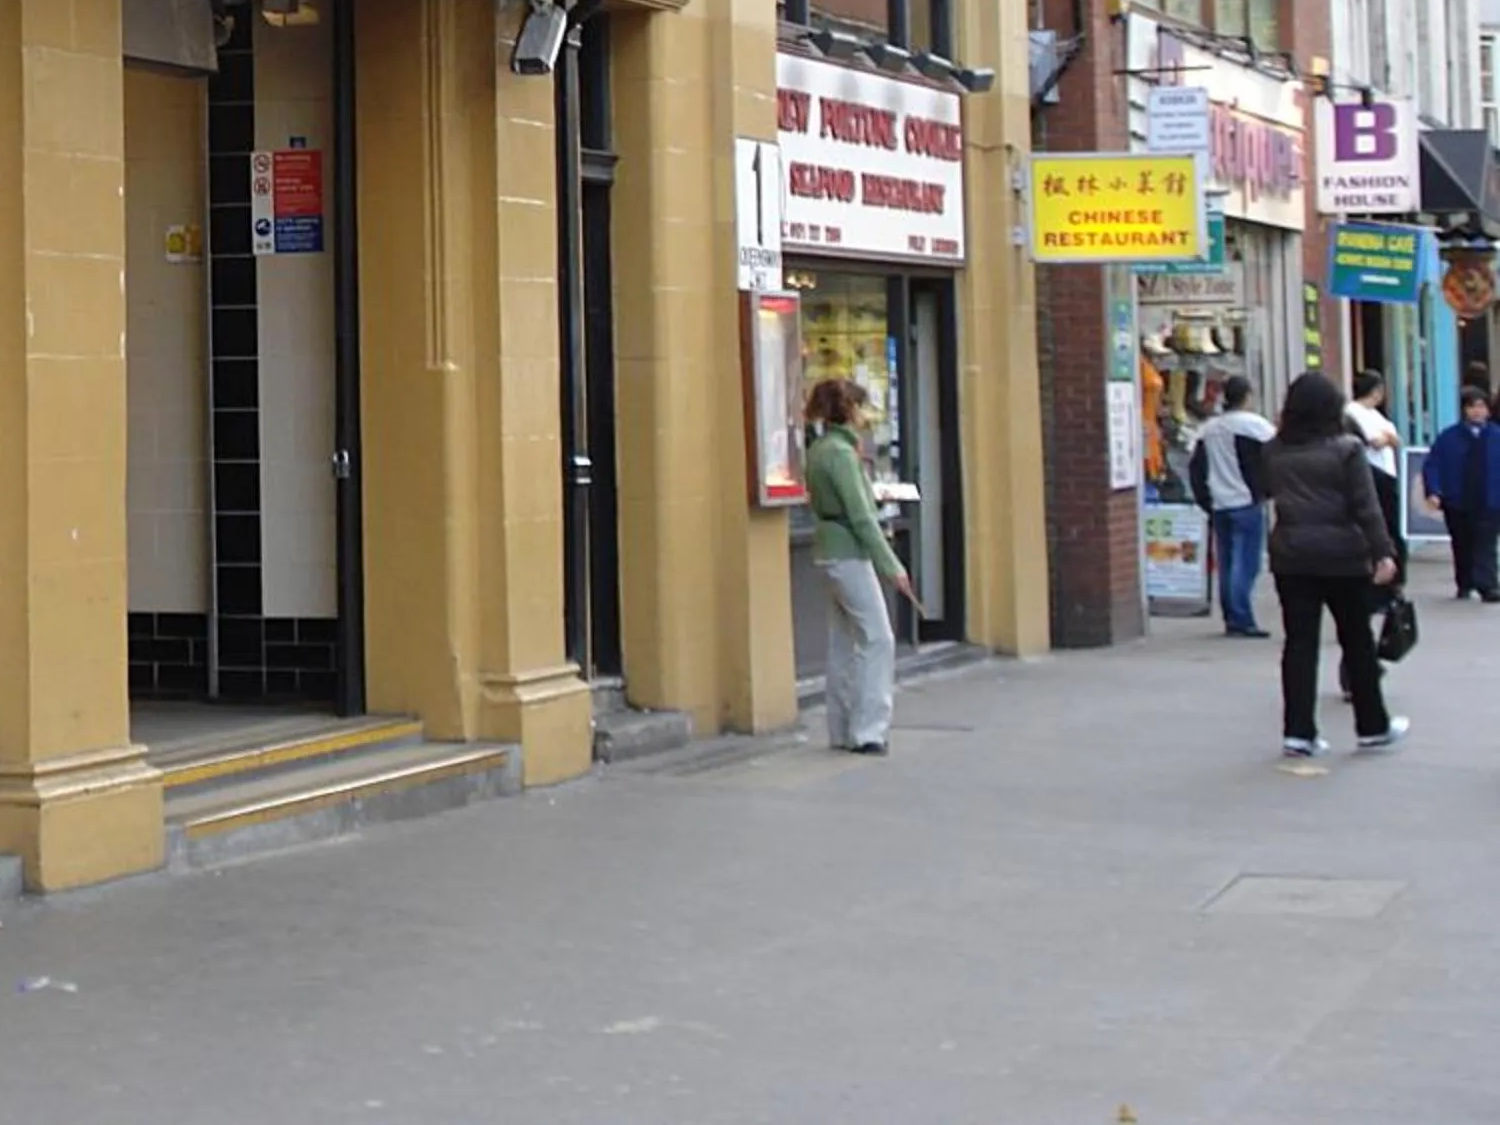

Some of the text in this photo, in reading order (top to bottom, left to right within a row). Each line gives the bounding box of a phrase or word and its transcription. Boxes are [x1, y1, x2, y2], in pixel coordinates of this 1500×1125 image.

[819, 96, 898, 151] FORTUNE
[1334, 102, 1398, 162] B
[1323, 176, 1410, 189] FASHION
[1334, 193, 1399, 207] HOUSE
[1068, 210, 1164, 225] CHINESE
[1044, 230, 1189, 247] RESTAURANT
